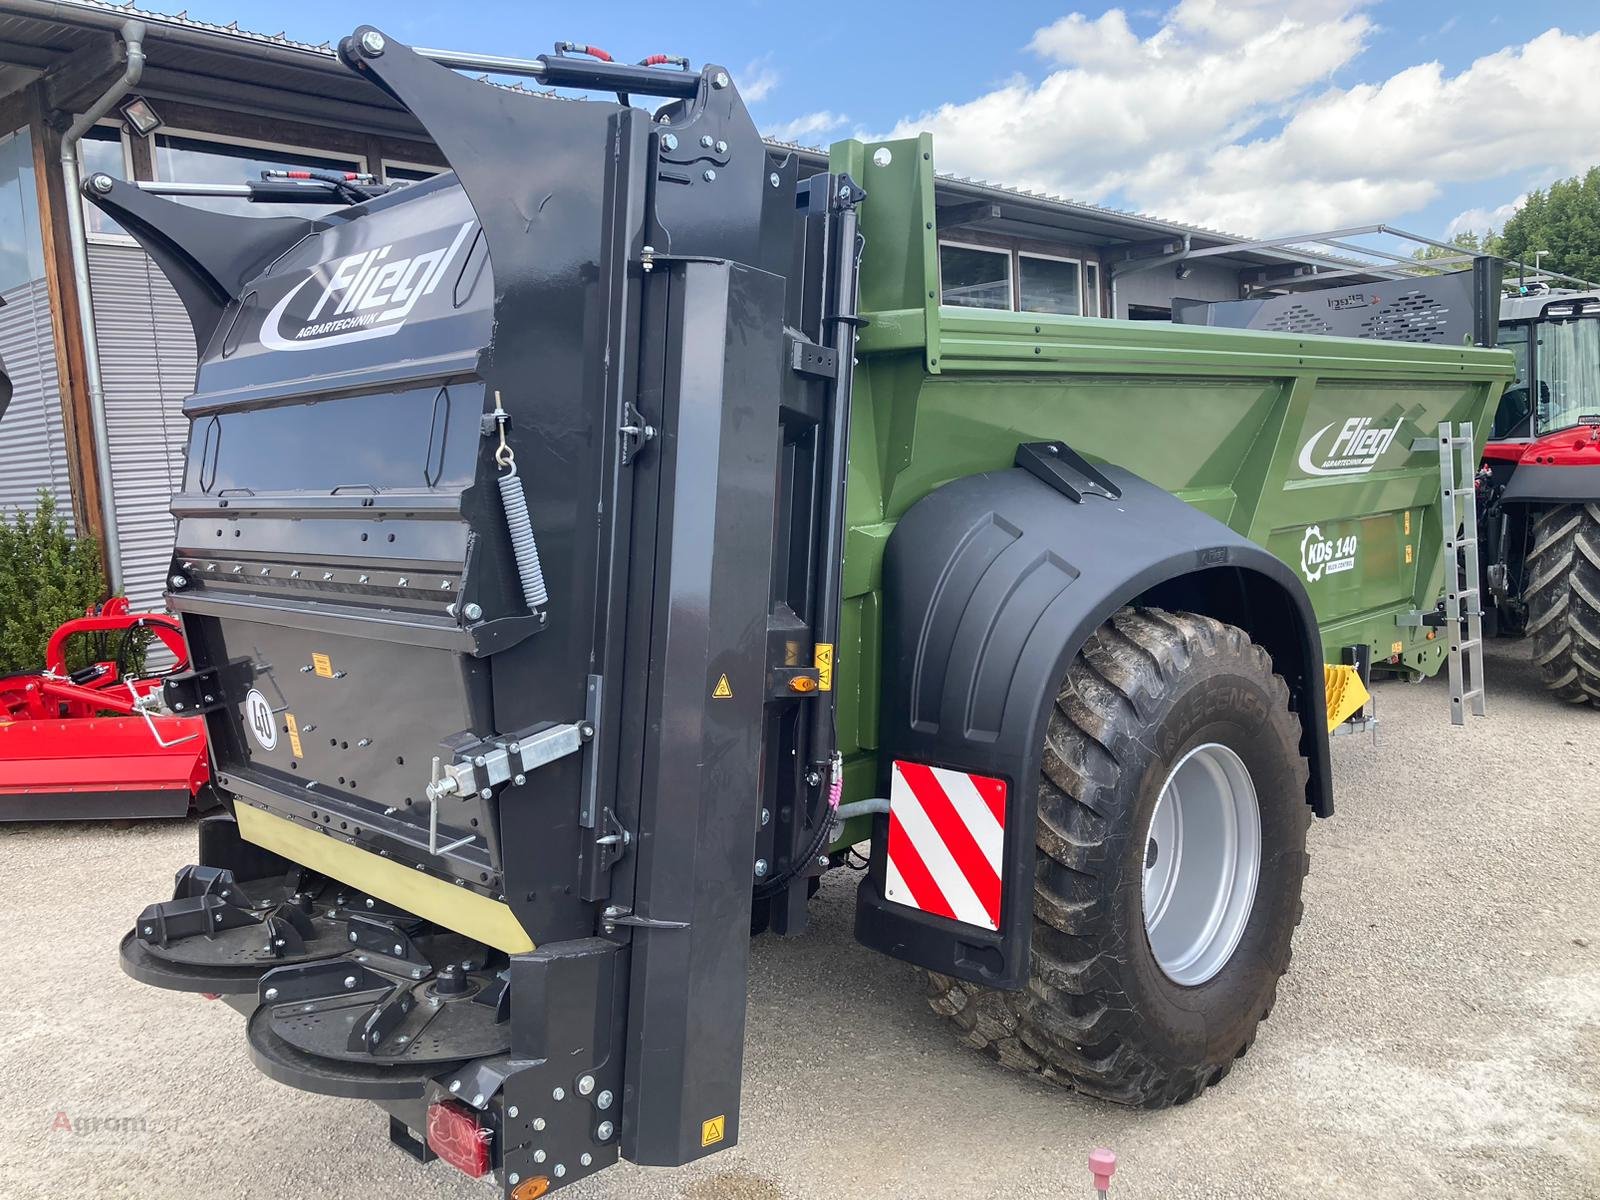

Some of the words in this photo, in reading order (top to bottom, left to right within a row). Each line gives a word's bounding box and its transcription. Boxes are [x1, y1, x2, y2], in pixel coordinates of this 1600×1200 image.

[307, 220, 474, 322] Fliegl
[295, 312, 379, 339] AGRARTECHNIK
[1328, 417, 1404, 464] Fliegl
[1308, 540, 1333, 564] KDS
[1335, 535, 1357, 558] 140
[252, 700, 273, 740] 40
